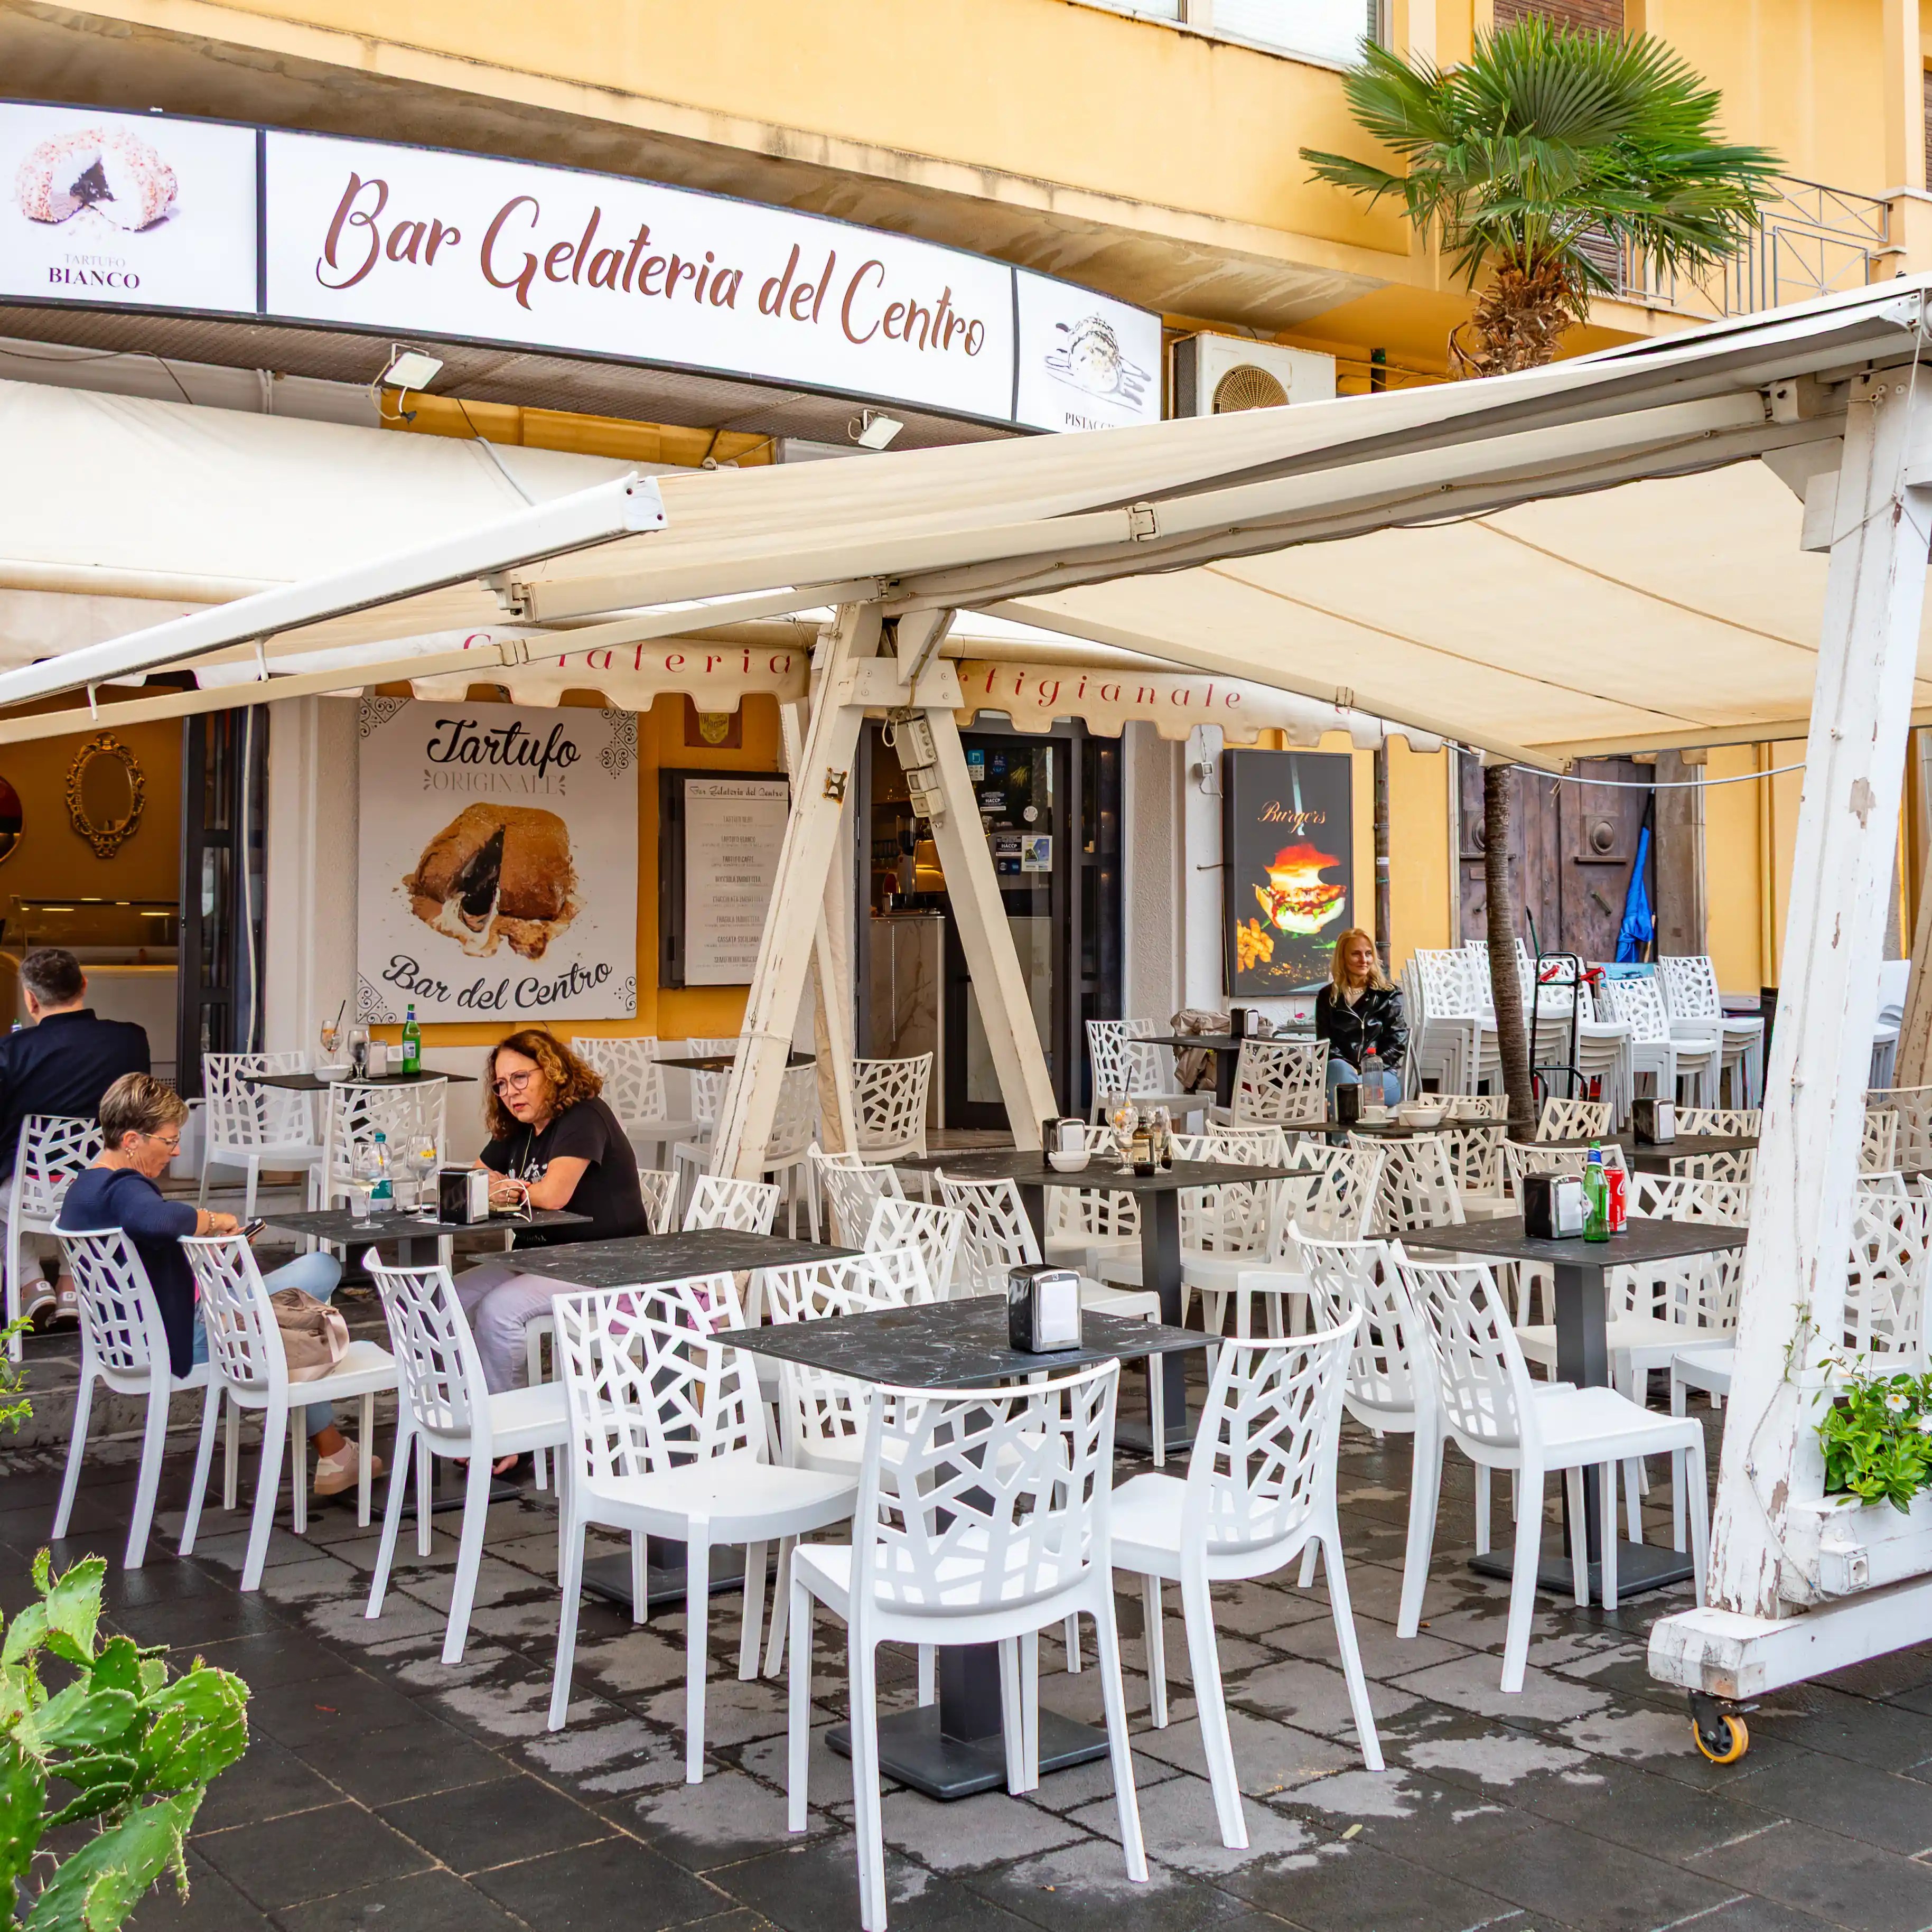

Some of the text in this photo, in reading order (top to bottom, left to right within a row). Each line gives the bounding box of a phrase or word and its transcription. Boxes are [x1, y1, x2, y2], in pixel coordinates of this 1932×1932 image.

[64, 254, 125, 267] TARTUFO
[317, 172, 985, 357] Bar Gelateria del Centro
[49, 267, 140, 289] BIANCO
[1066, 412, 1114, 430] PISTACC
[426, 719, 581, 779] Tartufo
[433, 770, 558, 794] ORIGINALE
[746, 787, 756, 796] del
[1257, 800, 1326, 834] Burgers
[382, 955, 613, 1010] Bar del Centro
